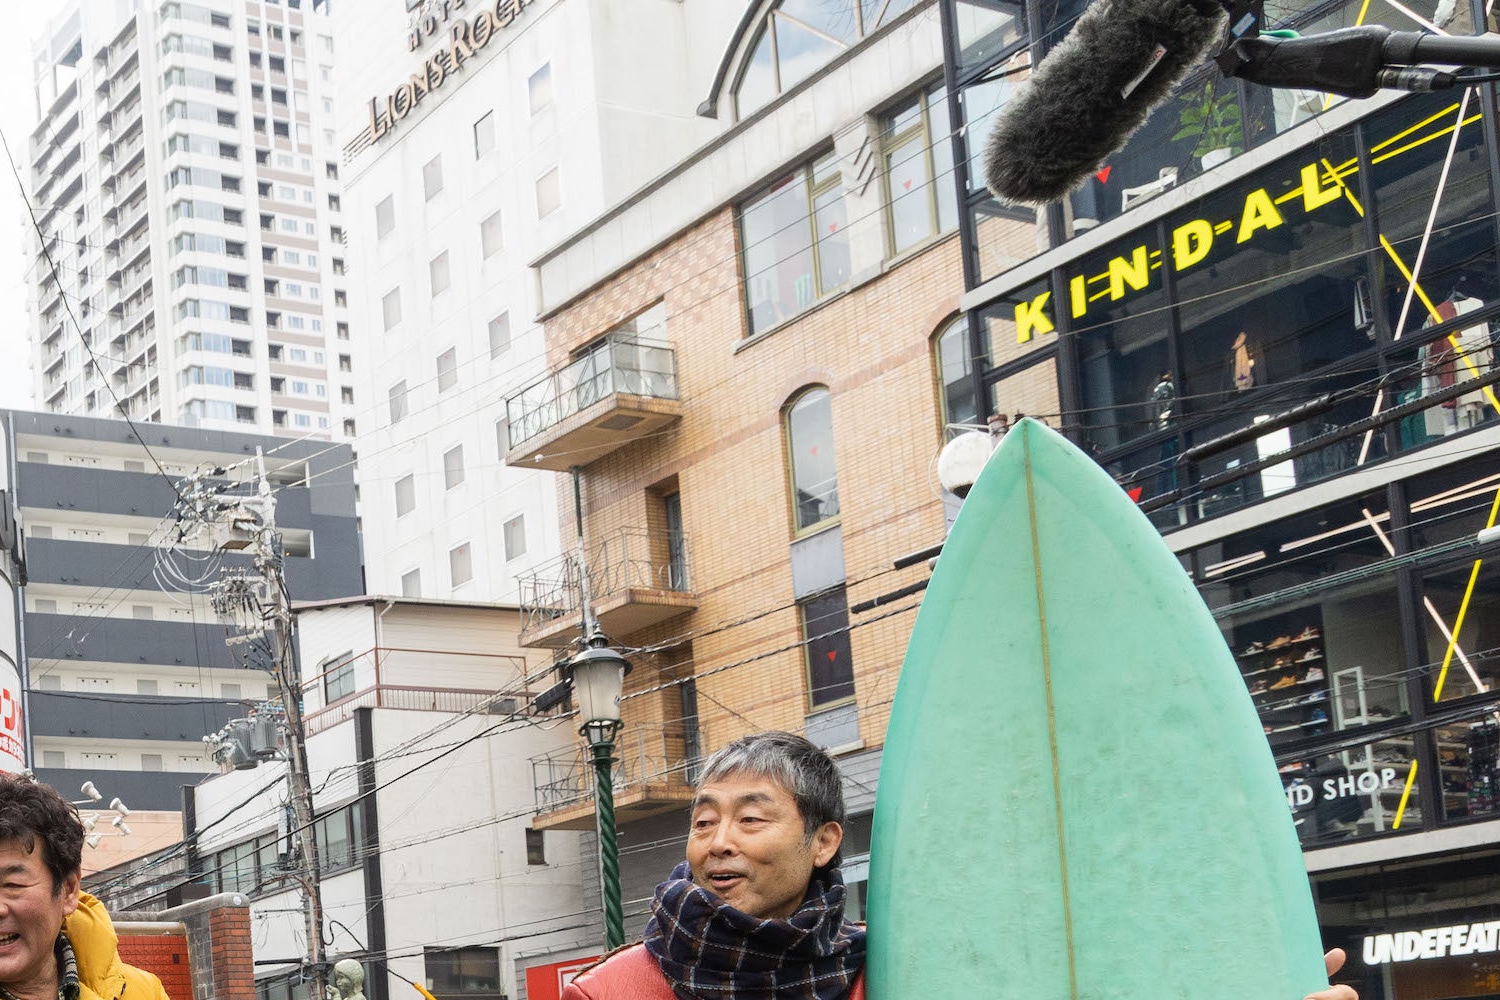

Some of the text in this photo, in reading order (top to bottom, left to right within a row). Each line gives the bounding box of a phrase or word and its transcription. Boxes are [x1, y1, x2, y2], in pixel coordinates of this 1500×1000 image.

[1014, 158, 1344, 344] KINDAL
[1322, 768, 1396, 801] SHOP
[1362, 920, 1500, 966] UNDEFEAT
